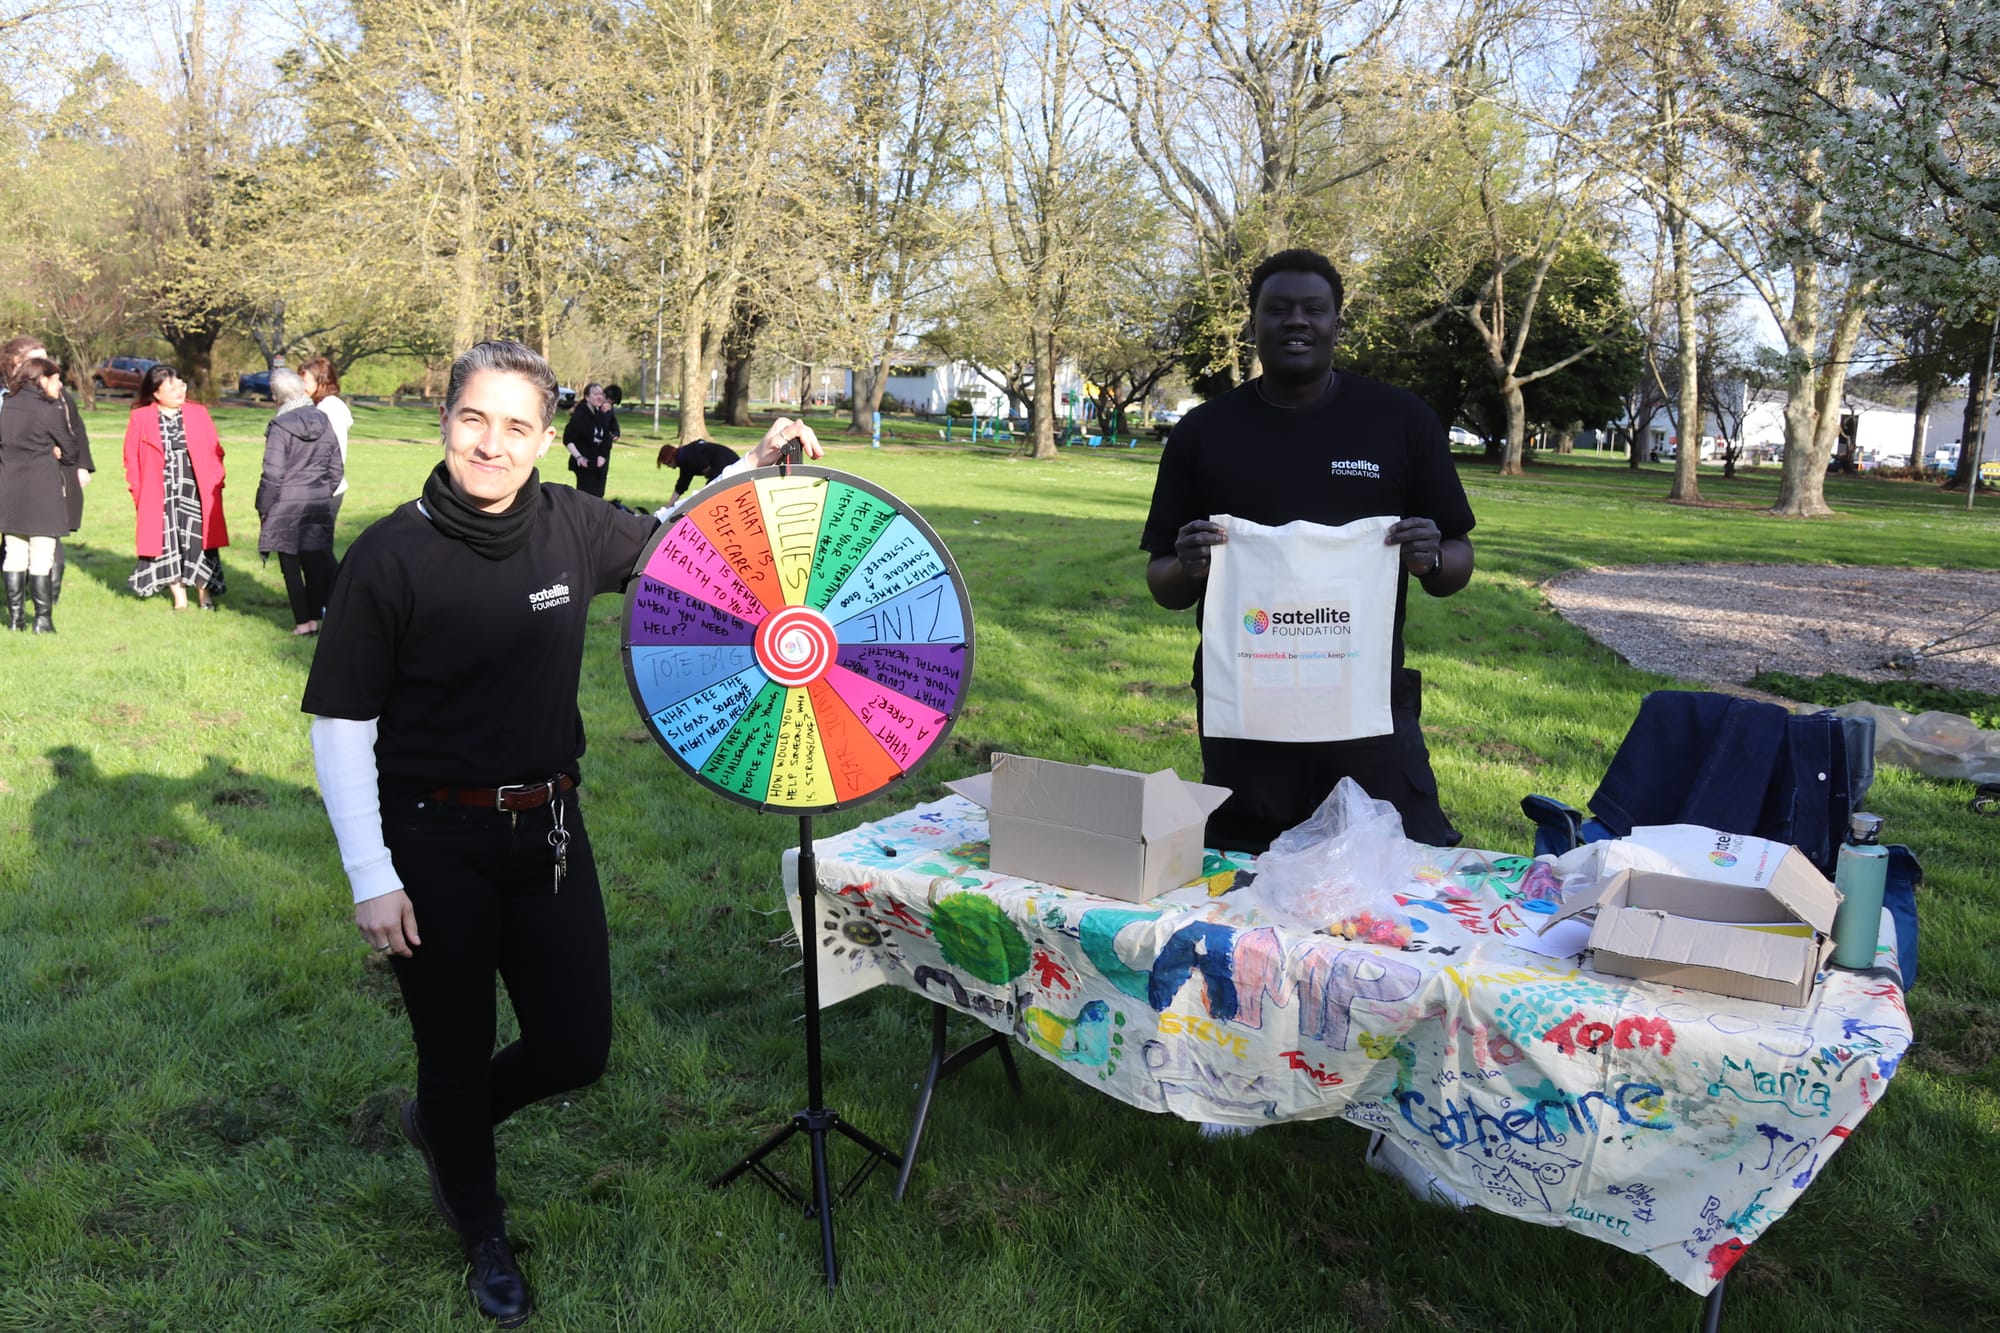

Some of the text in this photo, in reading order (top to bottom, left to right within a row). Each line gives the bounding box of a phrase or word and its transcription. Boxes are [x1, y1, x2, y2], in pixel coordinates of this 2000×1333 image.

[1331, 460, 1379, 472] satellite
[1331, 469, 1380, 479] FOUNDATION
[735, 490, 773, 567] WHAT IS
[769, 485, 818, 589] LOLLIES
[813, 488, 855, 579] MENTAL HEALTH?
[830, 501, 872, 557] HELP YOUR
[873, 510, 891, 534] HOW
[679, 522, 761, 615] WHAT IS MENTAL
[849, 537, 873, 561] DOES
[860, 536, 915, 584] LISTENER?
[529, 584, 569, 603] satellite
[663, 540, 753, 618] HEALTH TO YOU?
[840, 550, 930, 609] SOMEONE A GOOD
[865, 561, 940, 605] WHAT MAKES
[532, 596, 570, 611] FOUNDATION
[638, 598, 729, 637] WHEN YOU NEED
[644, 581, 744, 630] WHERE CAN YOU GO
[857, 585, 960, 643] ZINE
[1272, 608, 1350, 624] satellite
[643, 620, 687, 637] HELP?
[1272, 626, 1351, 636] FOUNDATION
[642, 647, 744, 687] TOTE BAG
[858, 647, 960, 679] MENTAL HEALTH?
[1238, 651, 1252, 659] stay
[1288, 652, 1298, 660] be
[1328, 652, 1345, 660] keep
[658, 676, 744, 726] WHAT ARE THE
[760, 691, 780, 718] YOUNG
[876, 673, 905, 691] COULD
[914, 690, 946, 710] WHAT
[925, 678, 955, 695] YOUR
[667, 683, 751, 740] SIGNS SOMEONE
[861, 707, 911, 763] WHAT IS
[868, 694, 930, 741] A CARER?
[677, 733, 707, 755] MIGHT
[708, 718, 729, 739] NEED
[706, 700, 763, 774] WHAT ARE SOME
[739, 722, 774, 794] PEOPLE FACE?
[770, 708, 793, 798] HOW WOULD YOU
[790, 719, 803, 766] SOMEONE
[804, 713, 816, 802] IS STRUGGLING?
[812, 684, 876, 792] STAR JUMP
[786, 773, 798, 800] HELP
[1079, 907, 1422, 1052] CAMP
[1157, 1011, 1249, 1060] STEVE
[1717, 1055, 1831, 1112] Maria
[1398, 1081, 1674, 1150] Catherine
